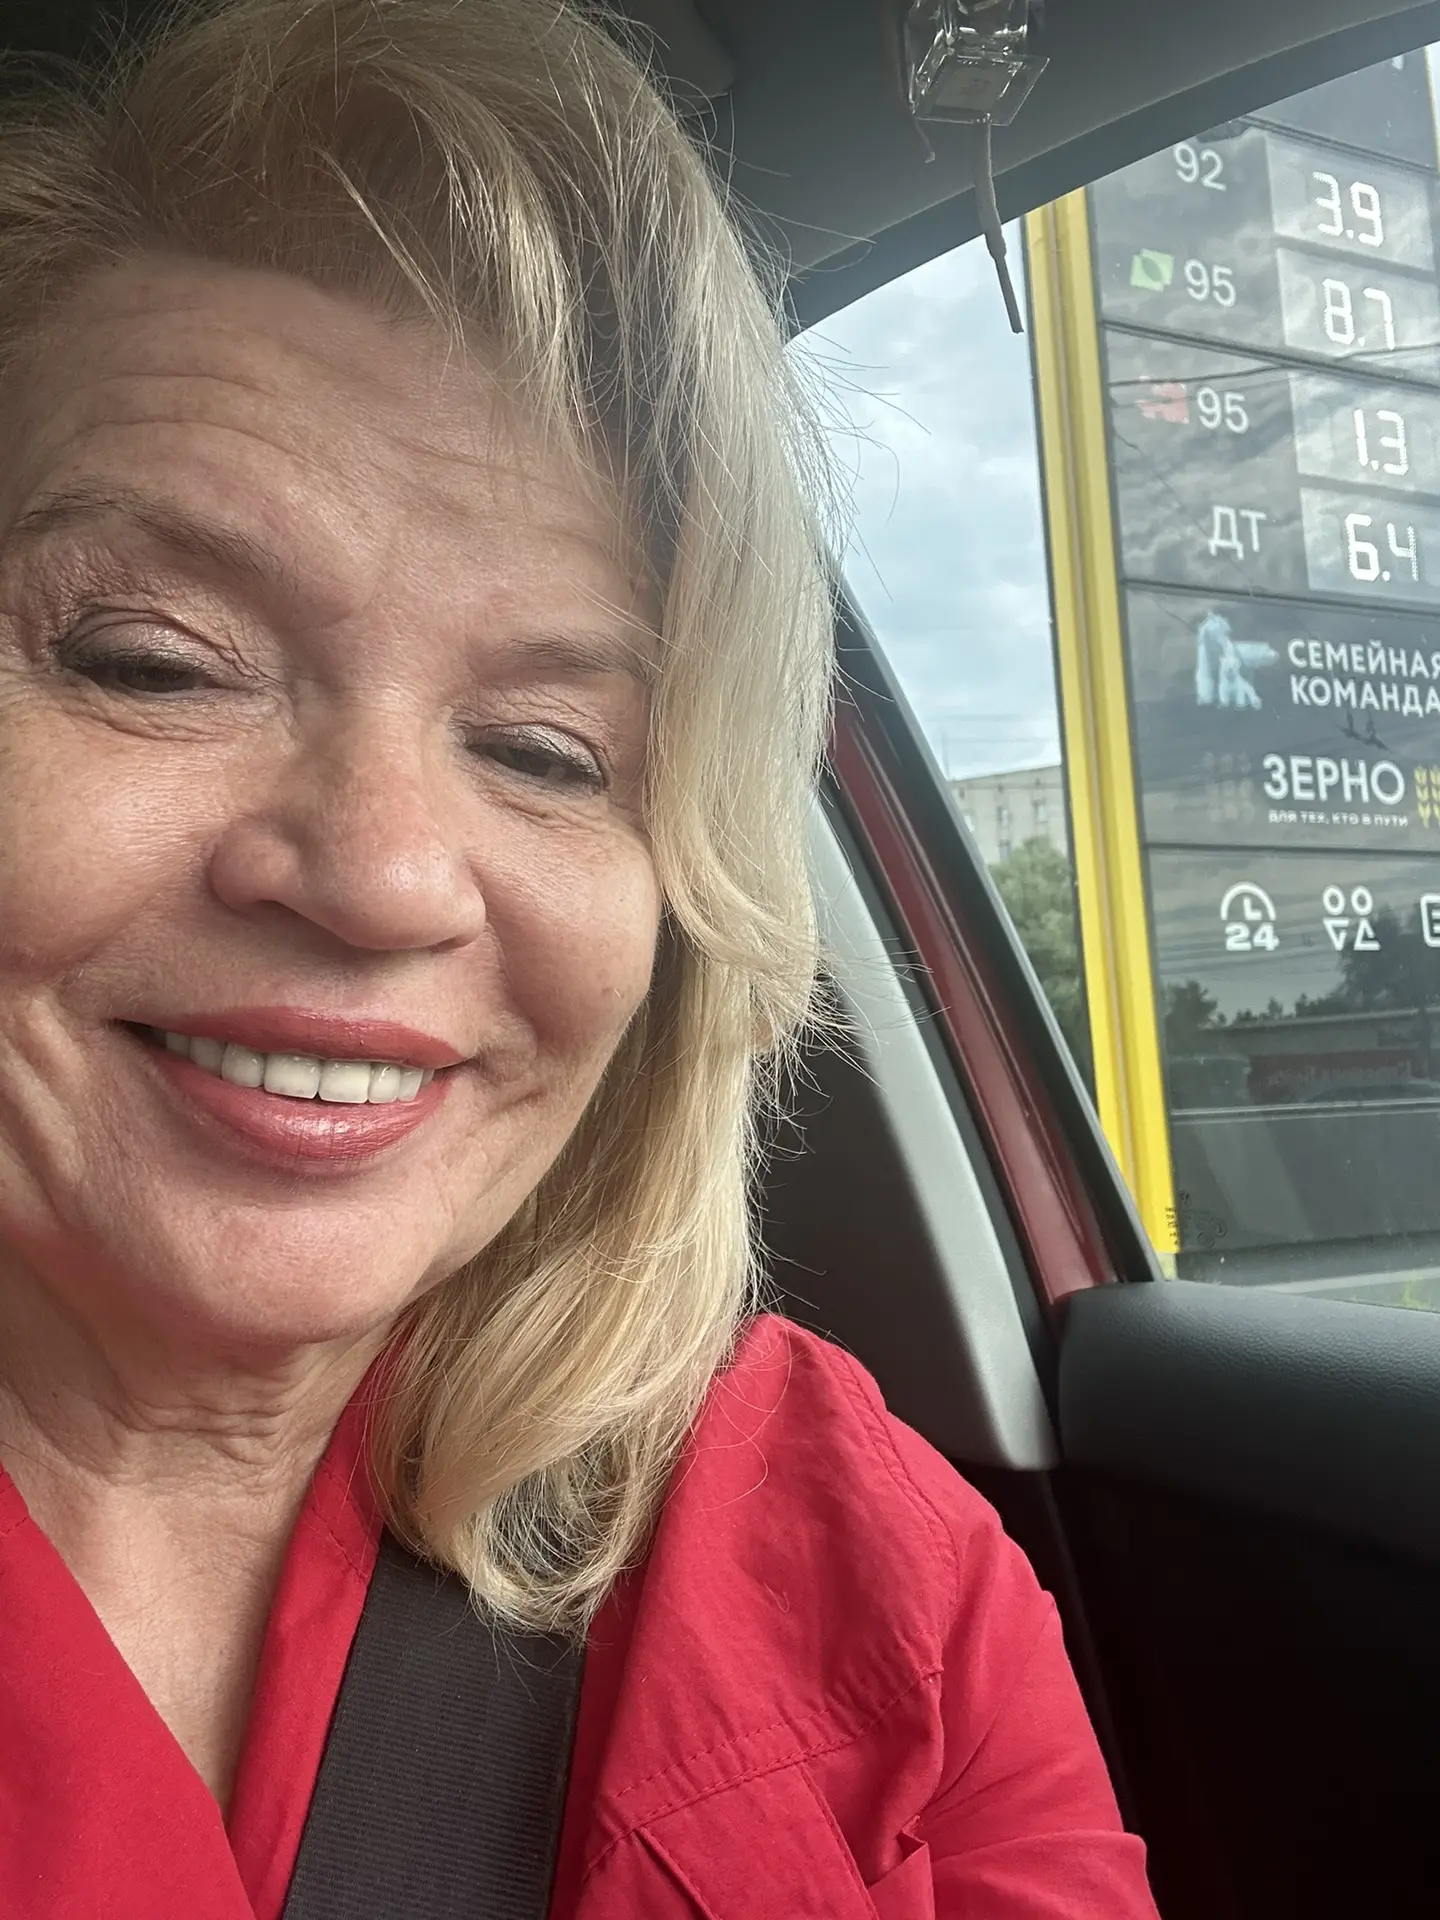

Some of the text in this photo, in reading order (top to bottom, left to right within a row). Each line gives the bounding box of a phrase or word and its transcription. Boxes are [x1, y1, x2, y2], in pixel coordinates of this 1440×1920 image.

[1172, 141, 1227, 191] 92
[1311, 171, 1385, 248] 3.9
[1183, 258, 1237, 307] 95
[1321, 278, 1395, 350] 8.7
[1196, 387, 1250, 434] 95
[1353, 408, 1409, 476] 1.3
[1208, 505, 1267, 560] ДТ
[1344, 513, 1420, 582] 6.4
[1289, 673, 1440, 718] КОМАНДА
[1262, 753, 1406, 805] ЗЕРНО
[1224, 921, 1280, 951] 24
